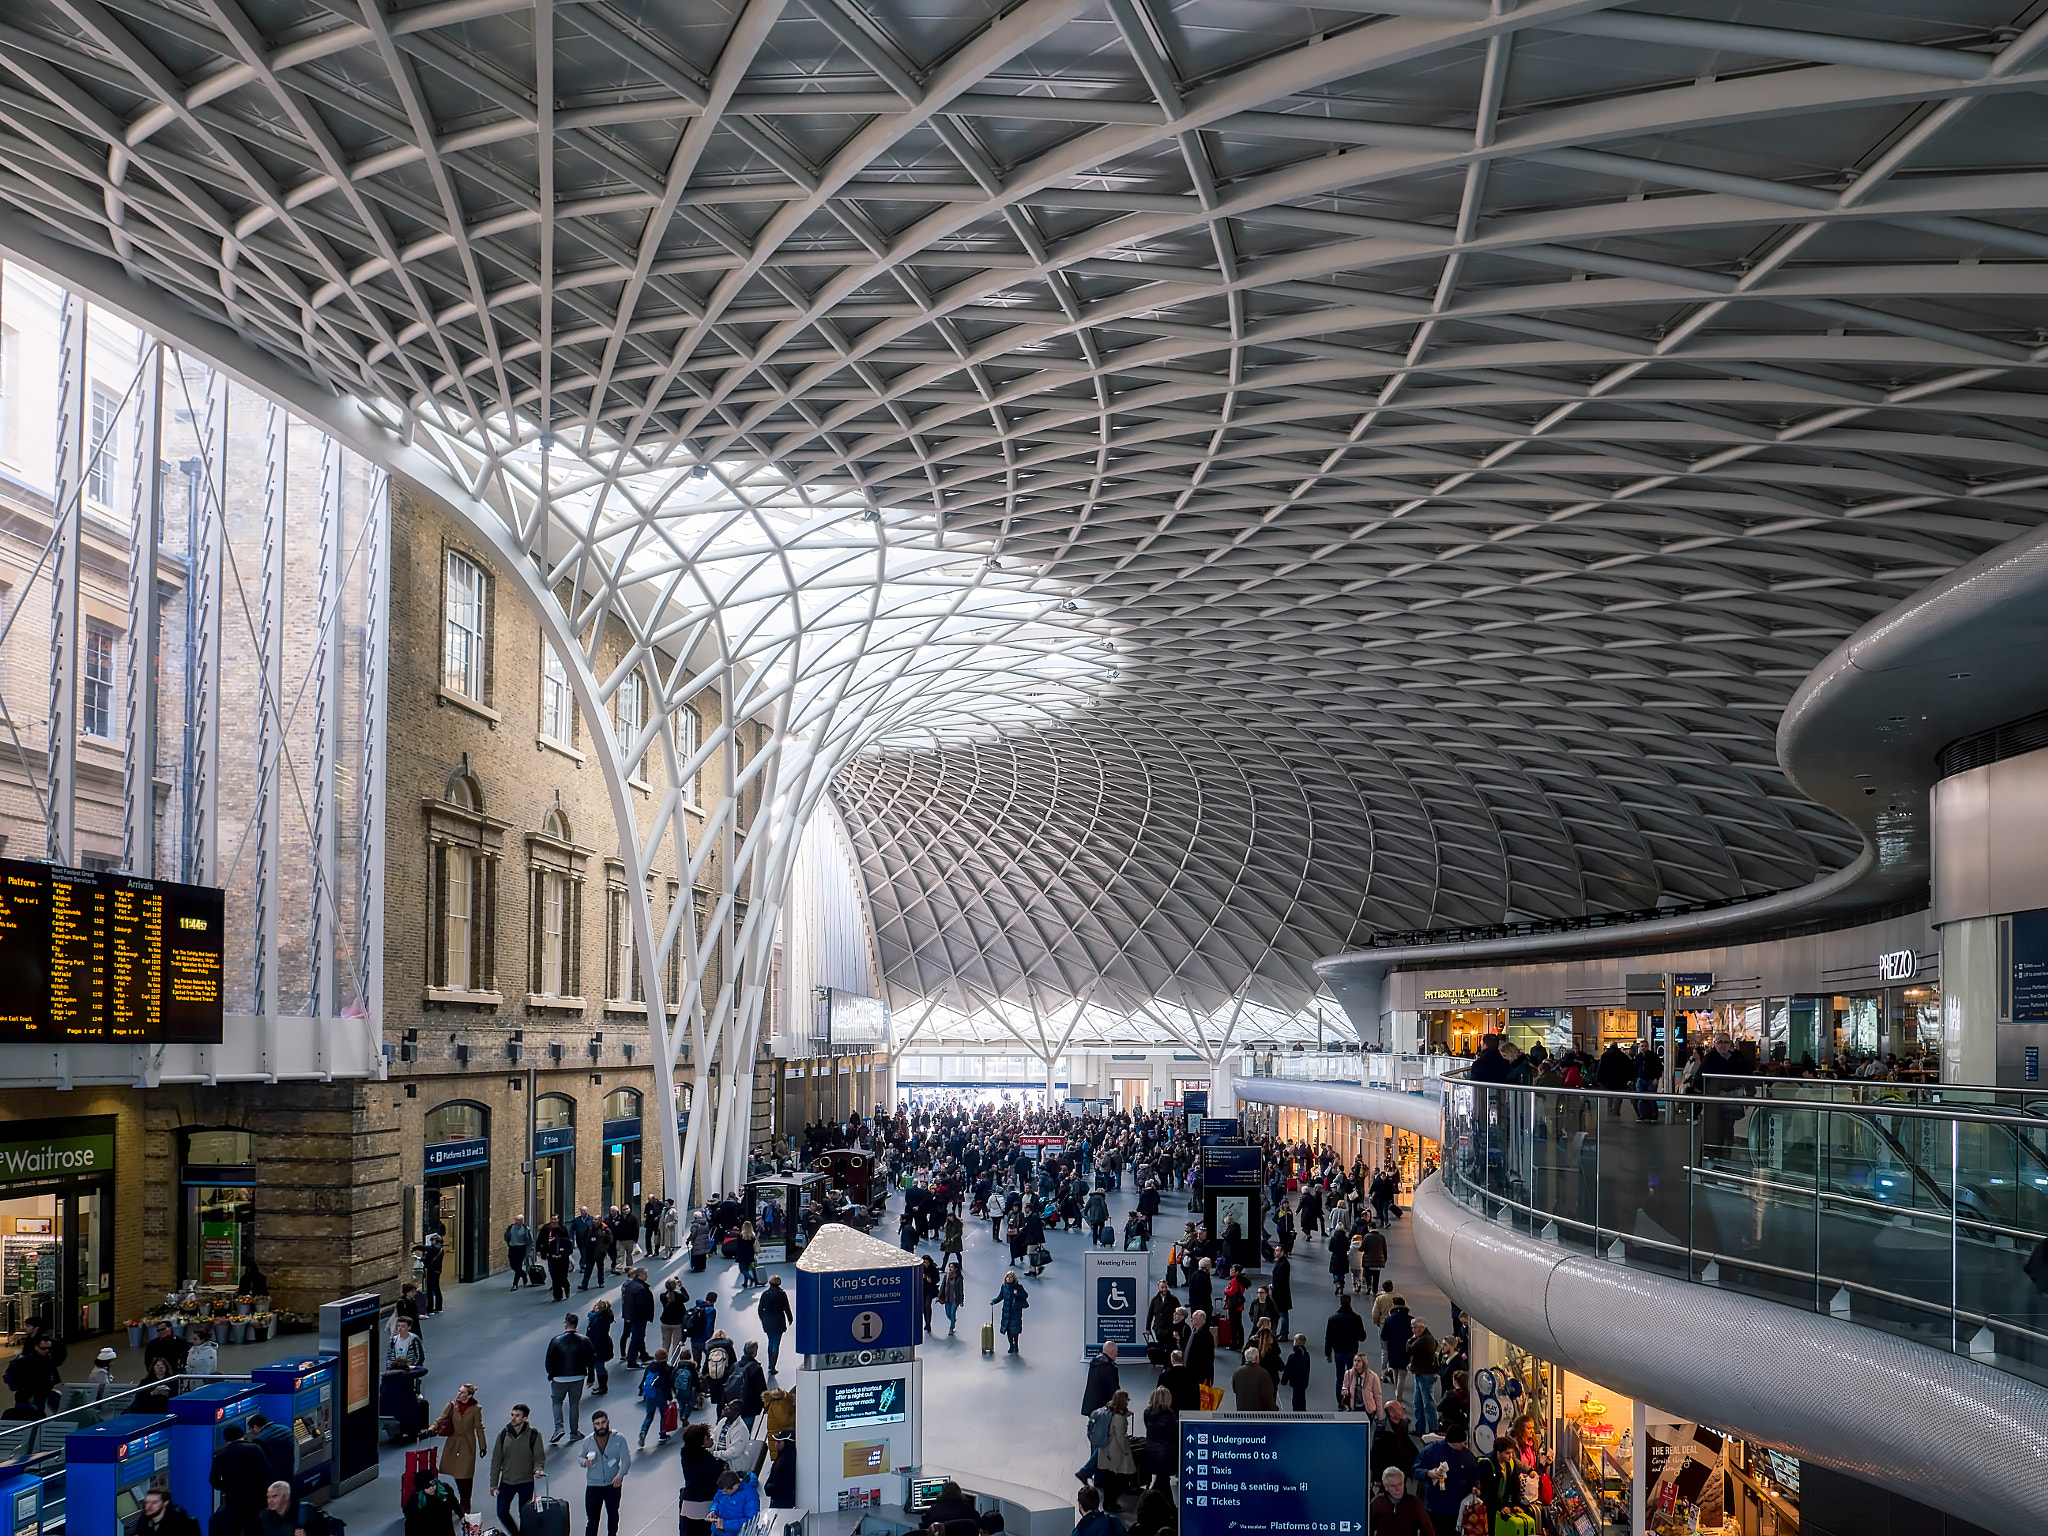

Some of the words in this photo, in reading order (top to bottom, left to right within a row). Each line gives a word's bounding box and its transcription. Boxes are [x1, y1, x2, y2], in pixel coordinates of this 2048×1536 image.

[8, 876, 36, 888] Platform
[128, 879, 154, 890] Arrivals
[52, 920, 76, 928] Cambridge
[1880, 950, 1913, 980] PREZZO
[1424, 989, 1465, 1000] PATISSERIE
[1466, 988, 1498, 997] VALERIE
[443, 1150, 462, 1160] Platforms
[466, 1148, 472, 1157] 10
[4, 1146, 94, 1174] Waitrose
[1096, 1260, 1120, 1268] Meeting
[833, 1276, 867, 1290] King's
[868, 1275, 901, 1286] Cross
[1485, 1404, 1497, 1412] PLAY
[1212, 1435, 1266, 1445] Underground
[1212, 1451, 1252, 1460] Platforms
[1652, 1446, 1664, 1456] THE
[1665, 1446, 1681, 1455] REAL
[1682, 1445, 1698, 1454] DEAL
[1672, 1456, 1692, 1469] through
[1211, 1466, 1232, 1475] Taxis
[1663, 1464, 1682, 1477] through
[1212, 1482, 1239, 1492] Dining
[1249, 1482, 1279, 1493] seating
[1211, 1498, 1241, 1506] Tickets
[1270, 1521, 1310, 1530] Platforms
